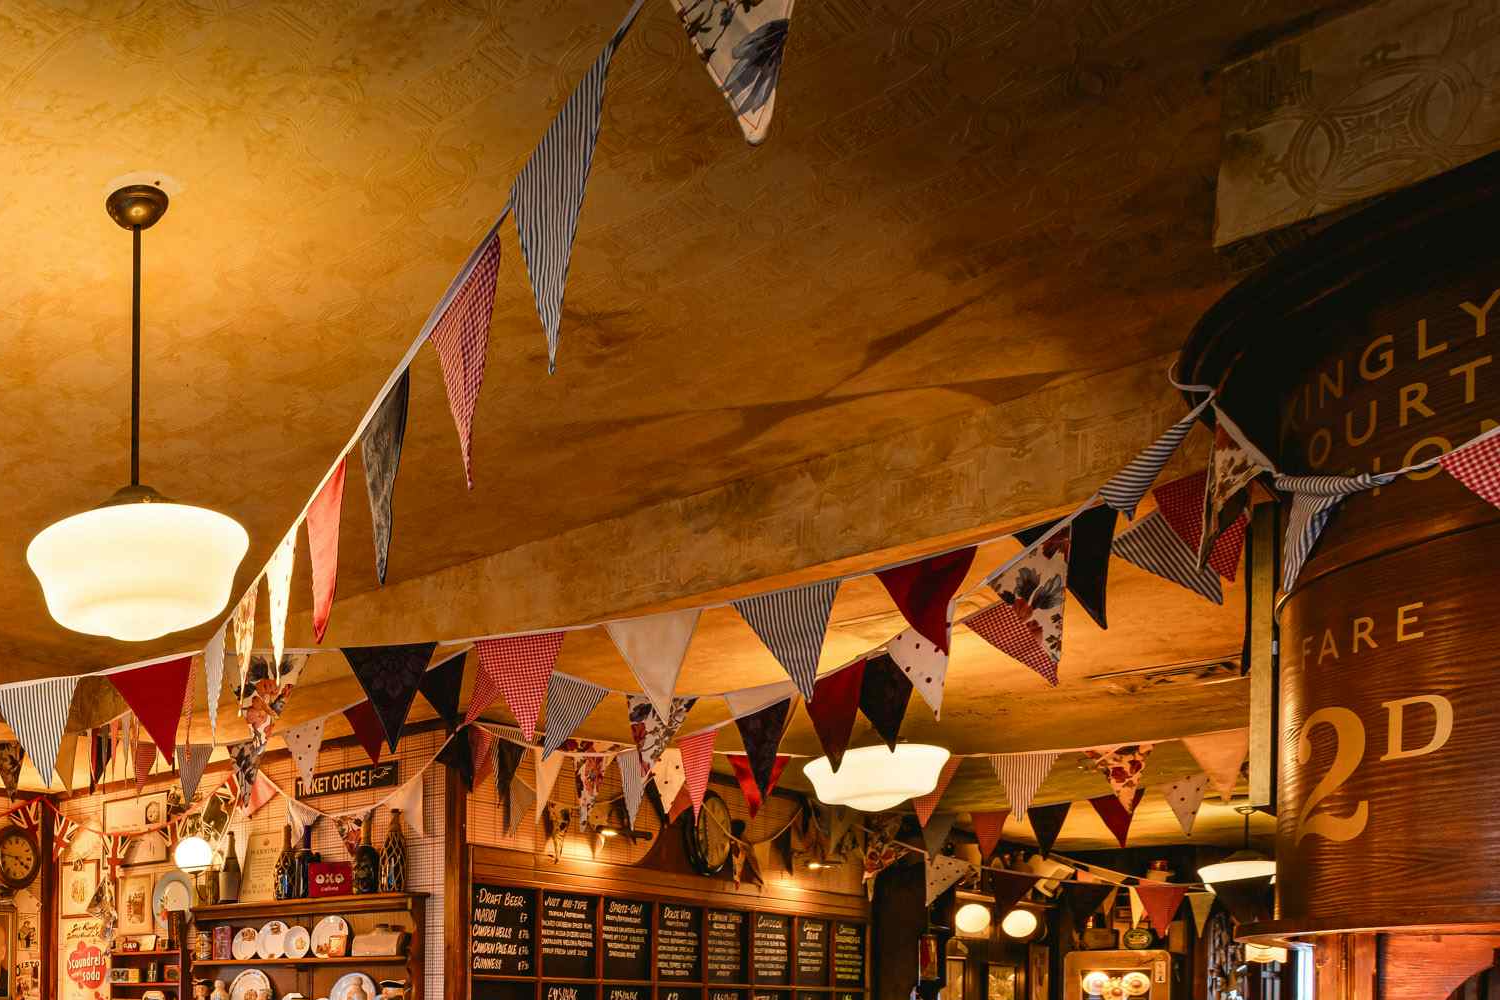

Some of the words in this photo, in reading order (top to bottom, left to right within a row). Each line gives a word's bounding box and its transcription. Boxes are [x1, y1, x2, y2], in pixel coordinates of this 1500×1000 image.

[1306, 355, 1493, 470] OURT
[1302, 601, 1425, 671] FARE
[331, 771, 366, 791] OFFICE
[315, 873, 345, 885] OXO
[82, 966, 101, 982] soda
